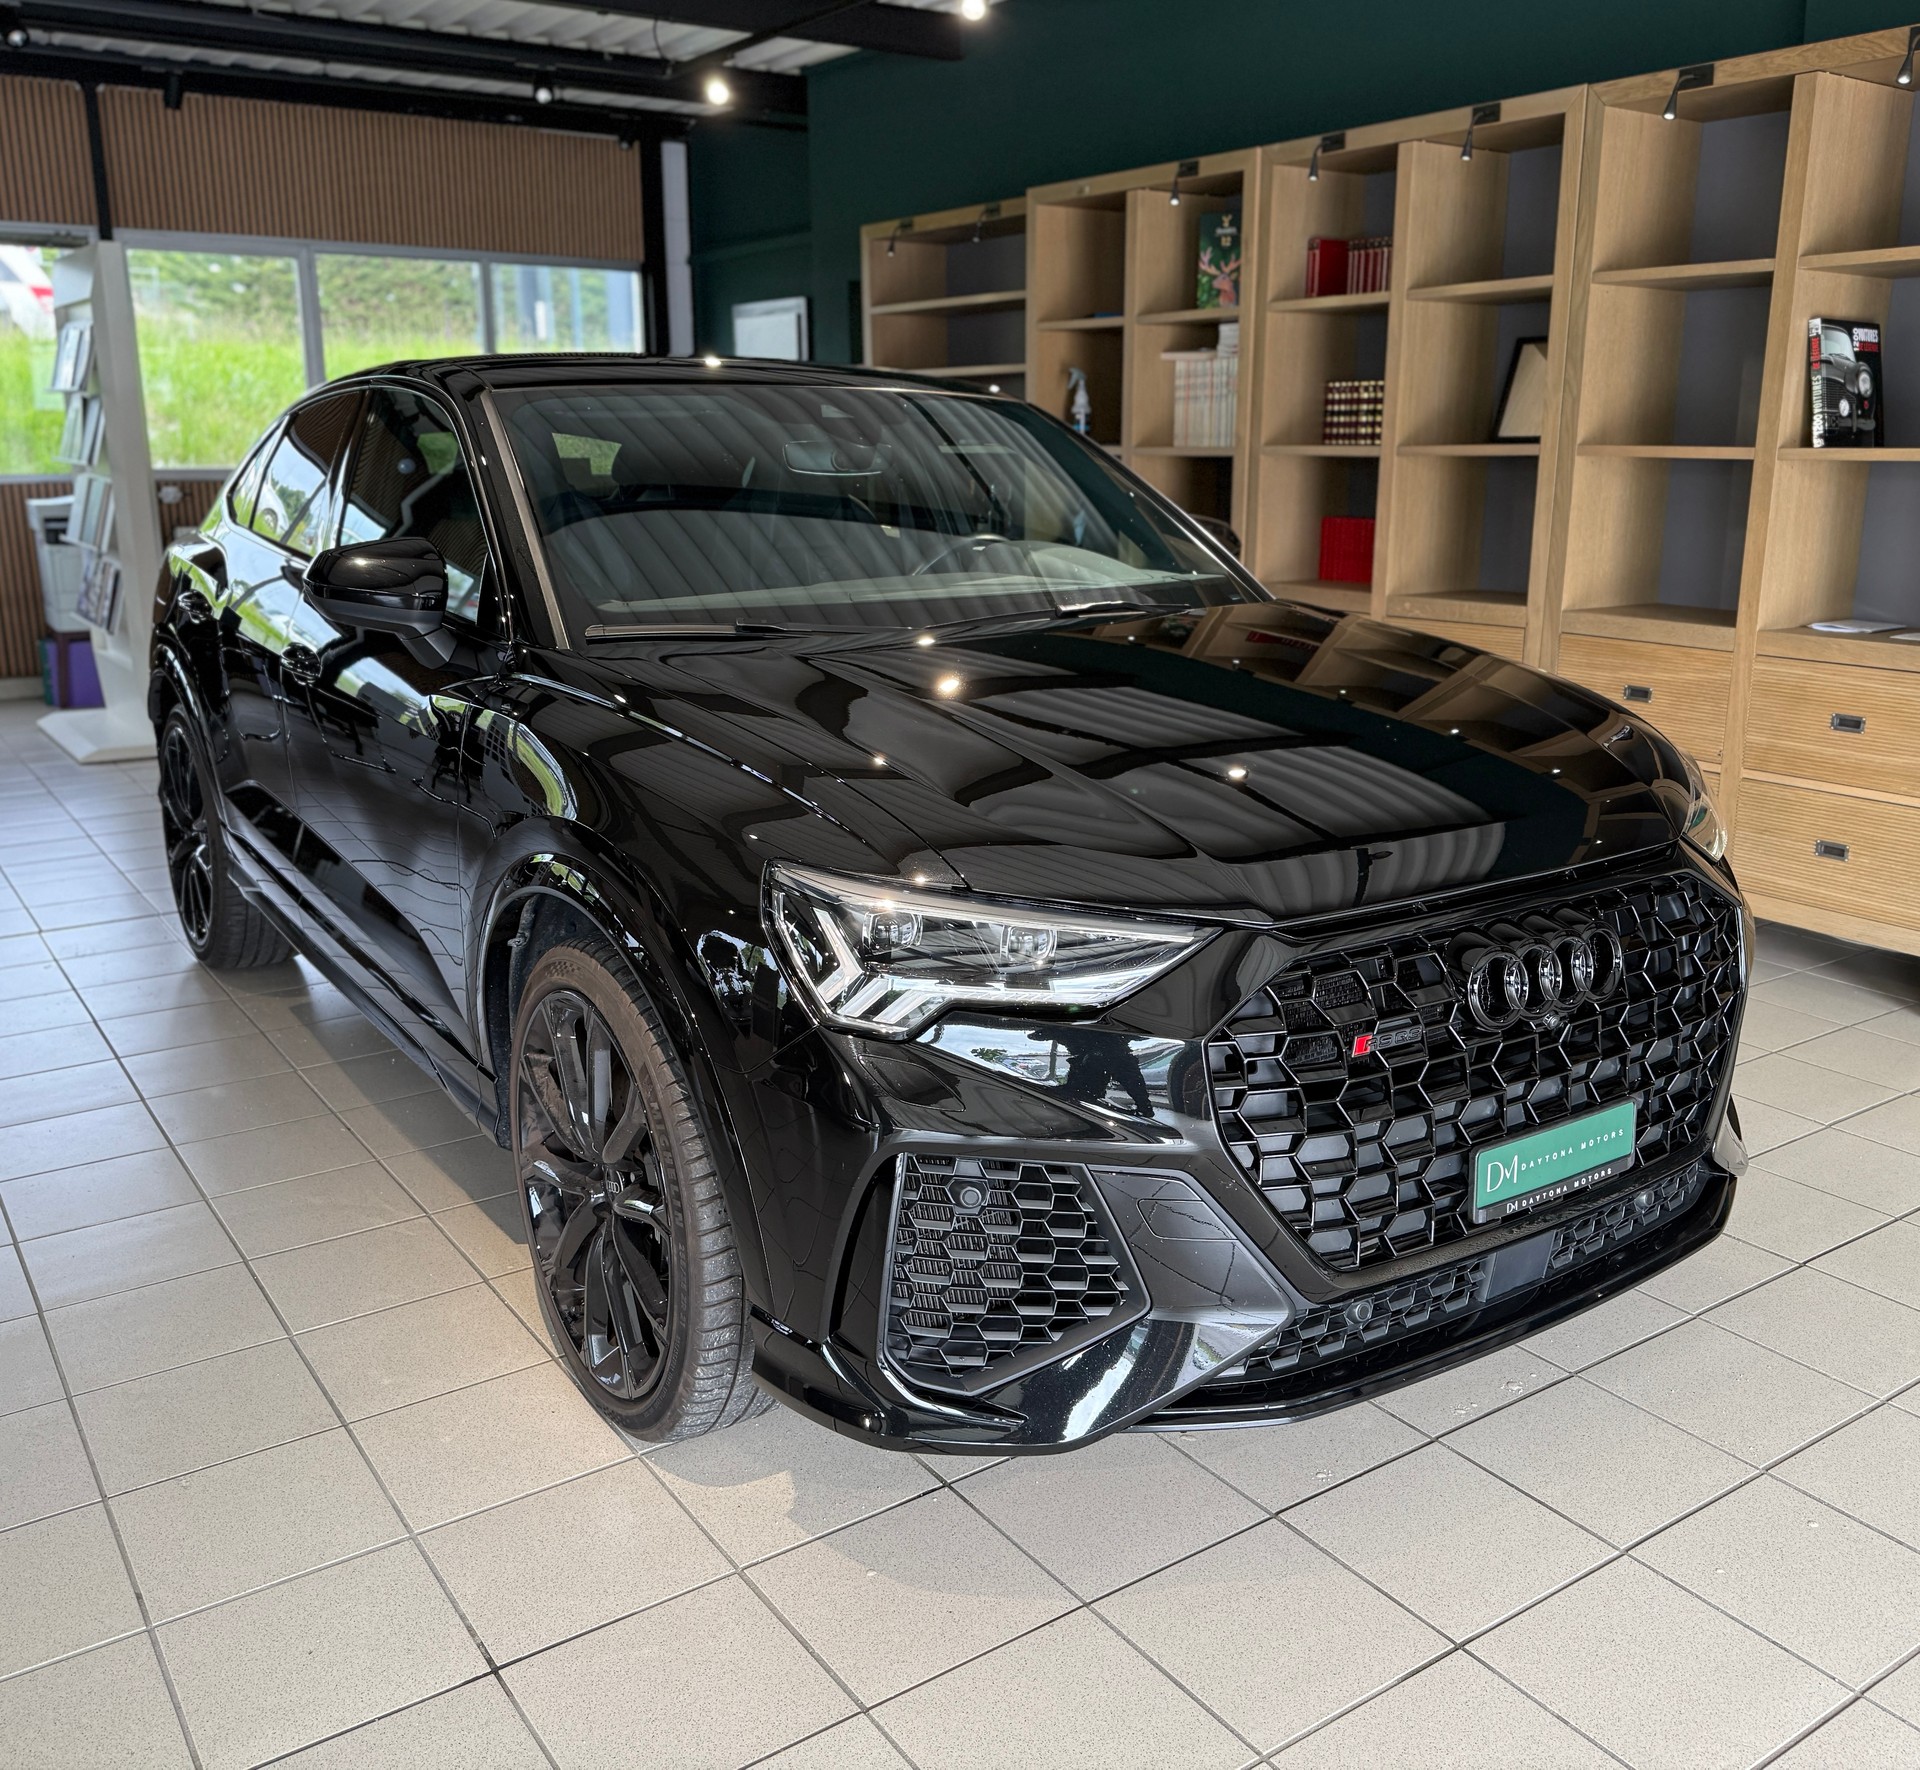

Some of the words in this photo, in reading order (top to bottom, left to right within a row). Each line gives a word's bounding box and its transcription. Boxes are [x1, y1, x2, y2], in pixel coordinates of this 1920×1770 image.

[1852, 327, 1860, 352] 1200
[1811, 375, 1822, 413] VOITURES
[1812, 413, 1824, 436] 1200
[650, 1101, 685, 1228] MICHELIN
[1521, 1146, 1573, 1171] DAYTONA
[1580, 1128, 1624, 1150] MOTORS
[1522, 1185, 1568, 1207] DAYTONA
[1574, 1167, 1612, 1187] MOTORS
